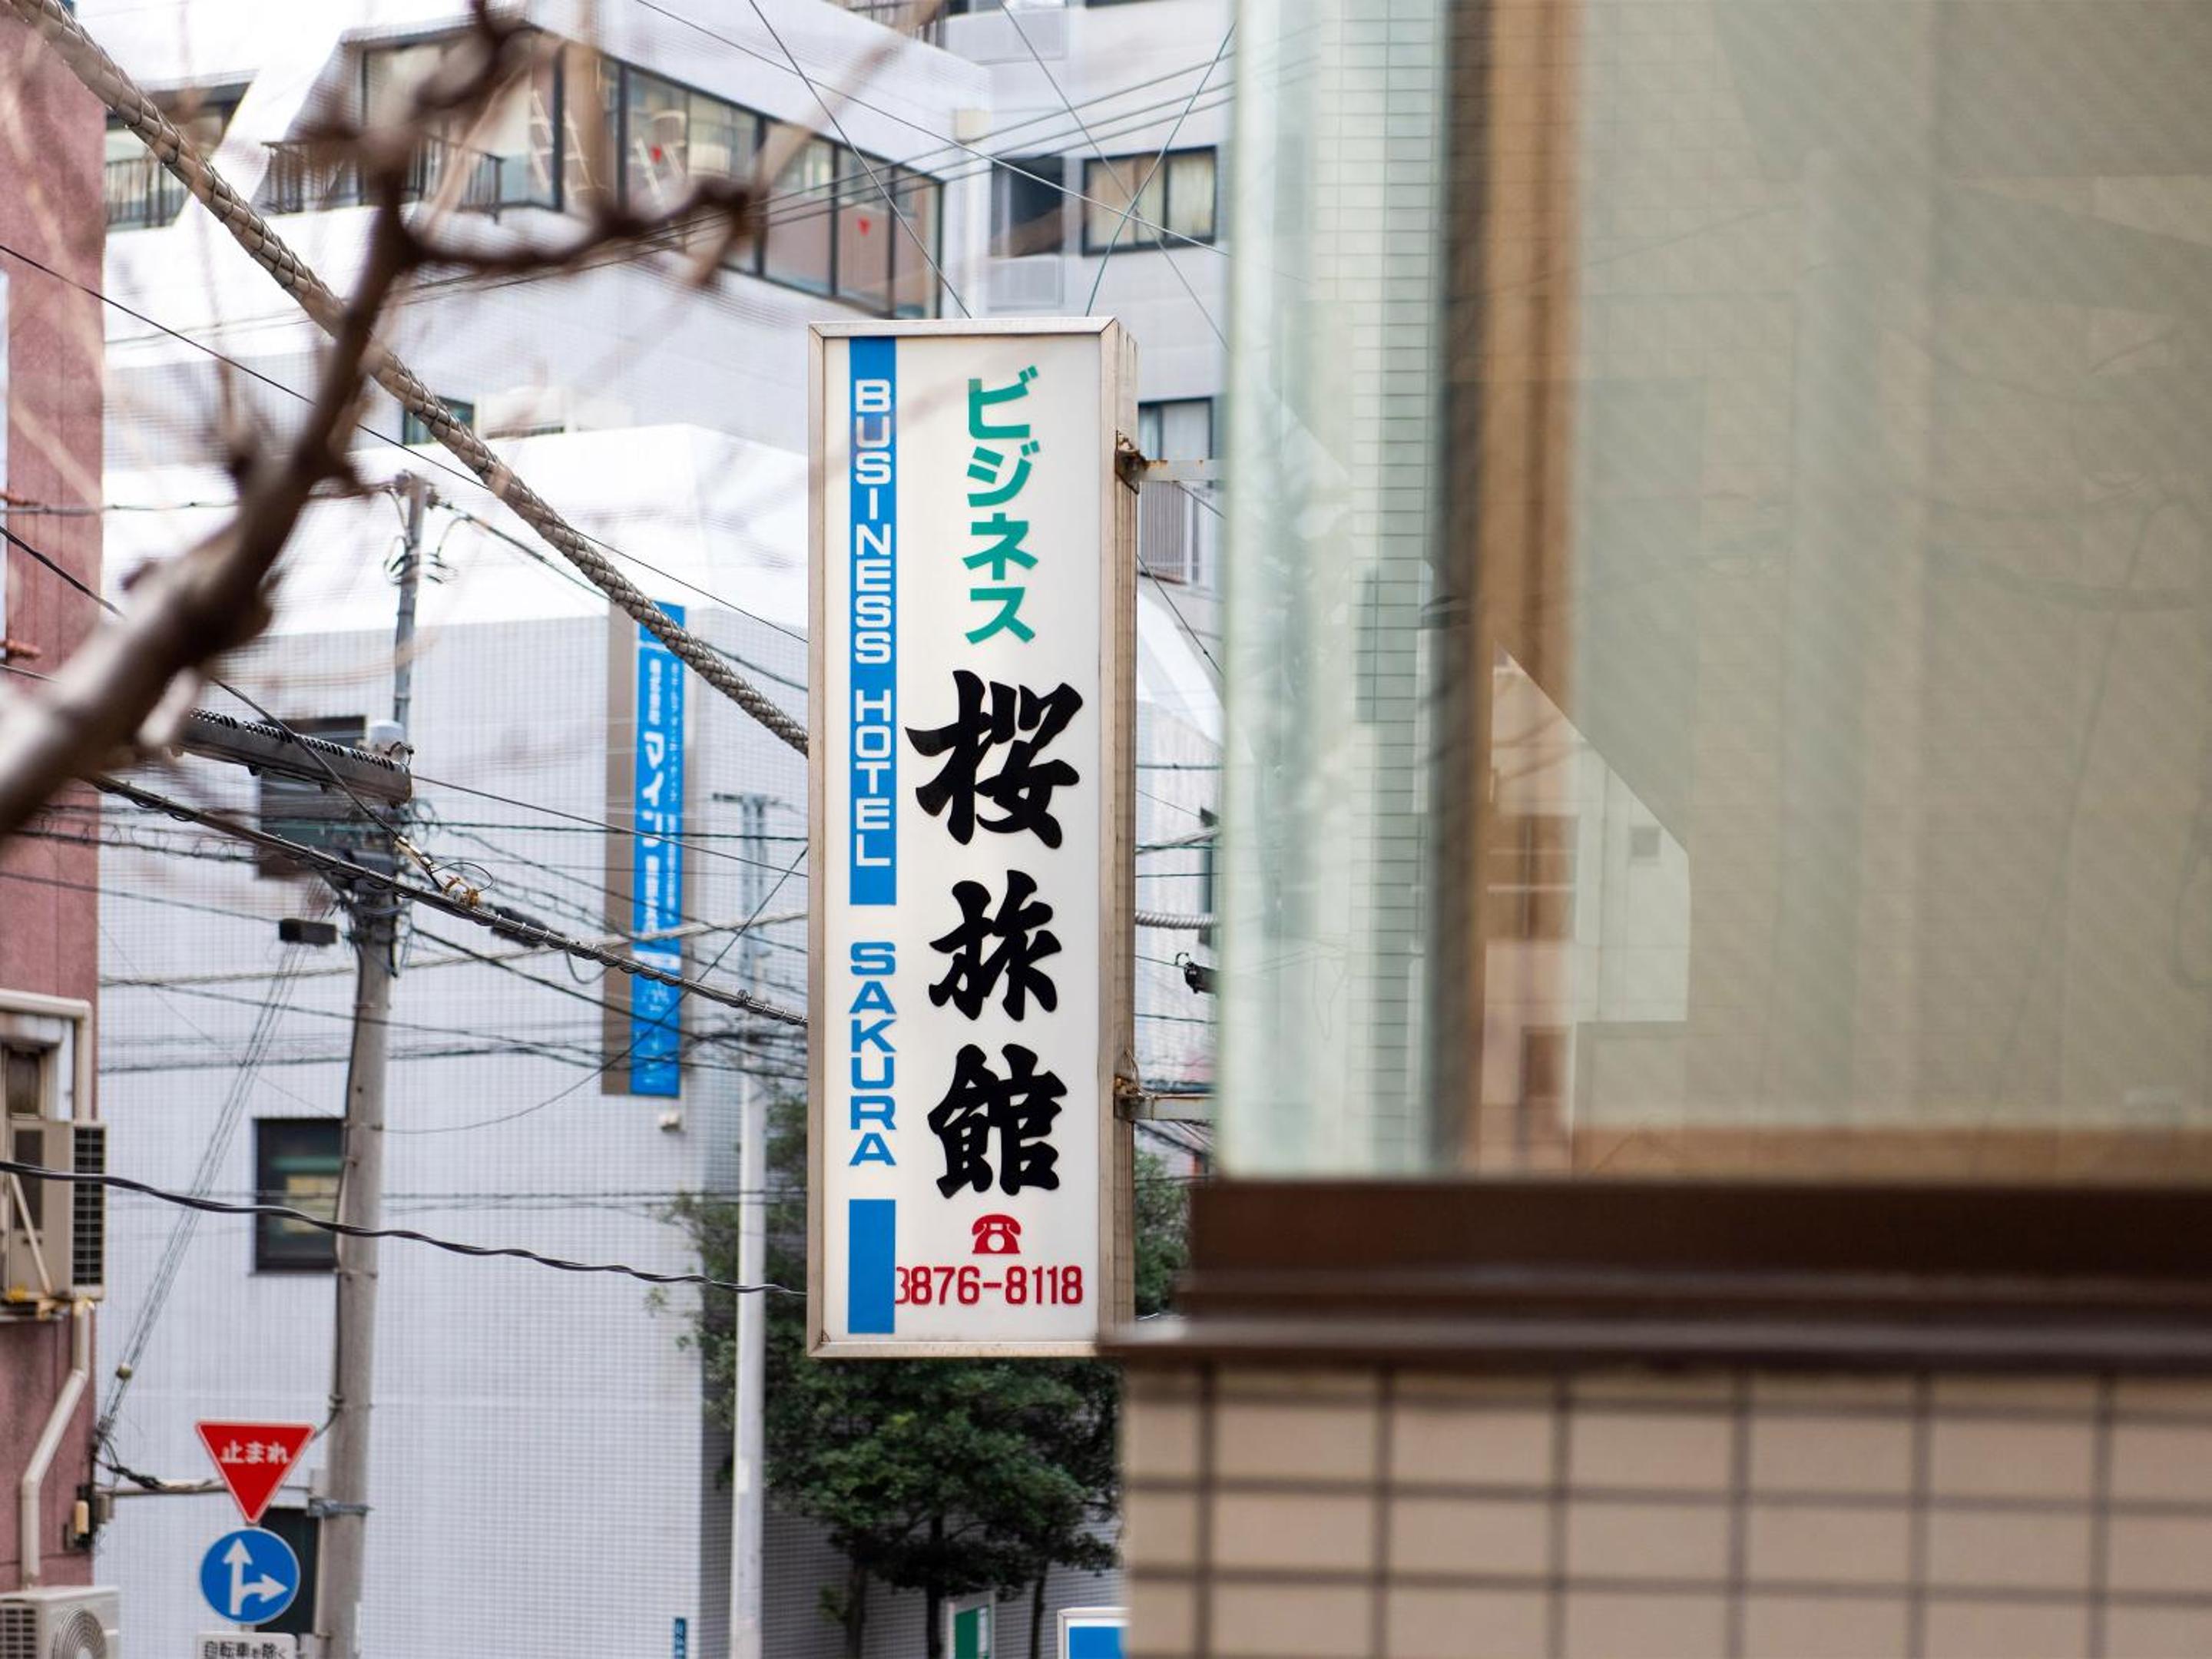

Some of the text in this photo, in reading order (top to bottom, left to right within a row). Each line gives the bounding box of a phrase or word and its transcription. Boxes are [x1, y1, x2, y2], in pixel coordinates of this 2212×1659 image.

[855, 379, 891, 866] BUSINESS HOTEL
[962, 365, 1040, 644] ビジネス
[849, 941, 896, 1166] SAKURA
[904, 669, 1084, 1200] 桜旅館
[895, 1265, 1084, 1306] 3876-8118
[220, 1439, 292, 1465] 止まれ
